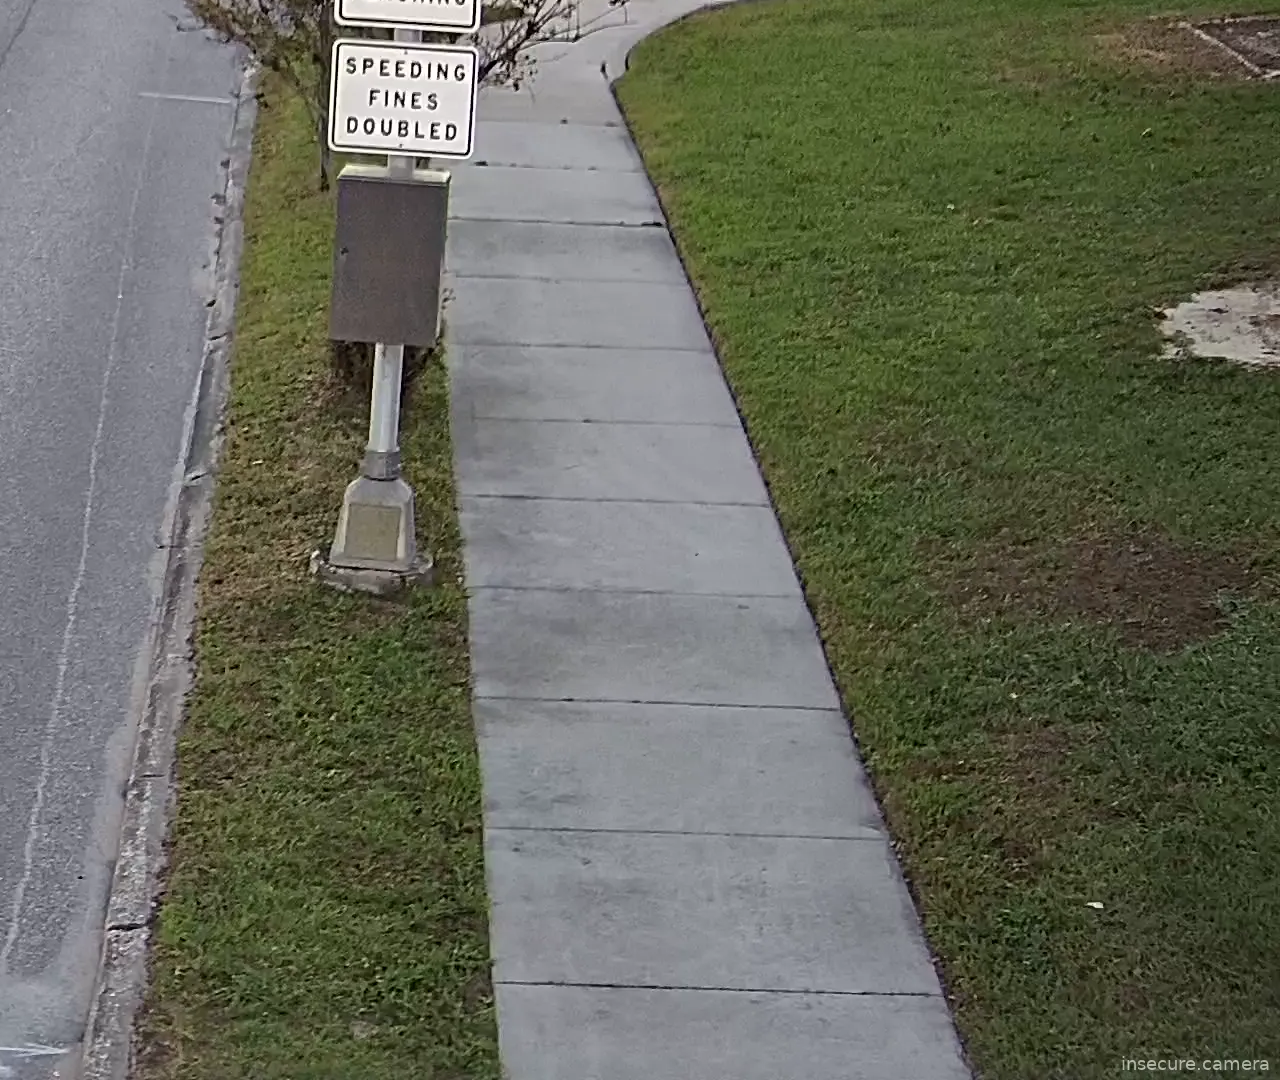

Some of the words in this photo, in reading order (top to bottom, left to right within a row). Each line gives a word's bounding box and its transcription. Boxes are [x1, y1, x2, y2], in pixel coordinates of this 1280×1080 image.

[346, 57, 466, 82] SPEEDING
[369, 89, 438, 111] FINES
[346, 116, 457, 141] DOUBLED
